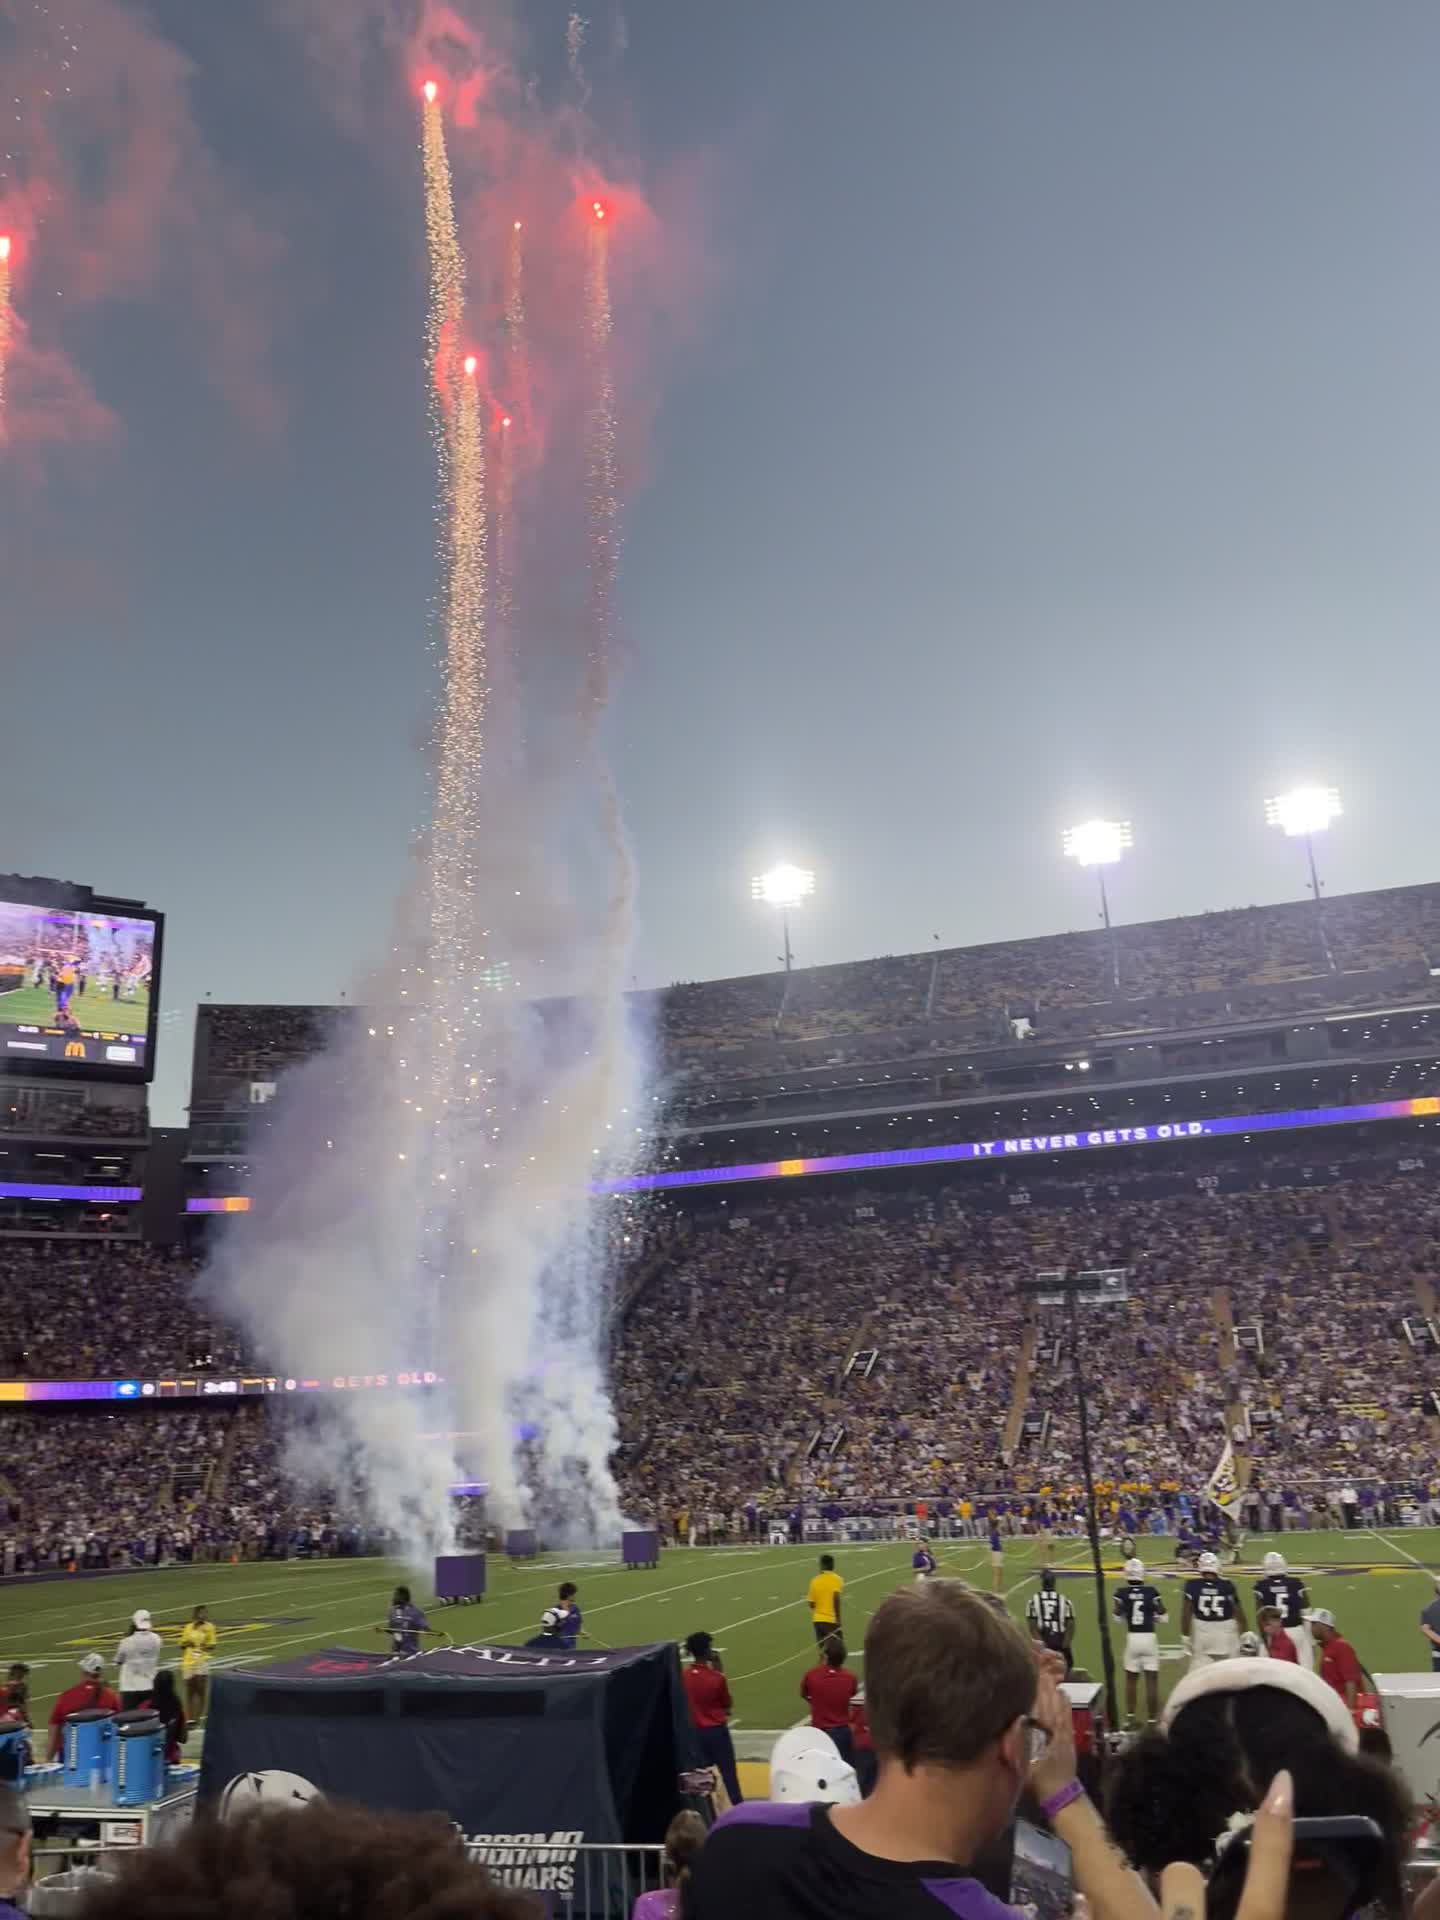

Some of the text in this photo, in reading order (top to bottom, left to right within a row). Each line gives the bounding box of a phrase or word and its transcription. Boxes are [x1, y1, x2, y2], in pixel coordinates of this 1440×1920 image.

[972, 1122, 1212, 1155] IT NEVER GETS OLD.
[333, 1374, 388, 1389] GETS
[1198, 1595, 1225, 1617] 55
[489, 1865, 576, 1890] GUARS
